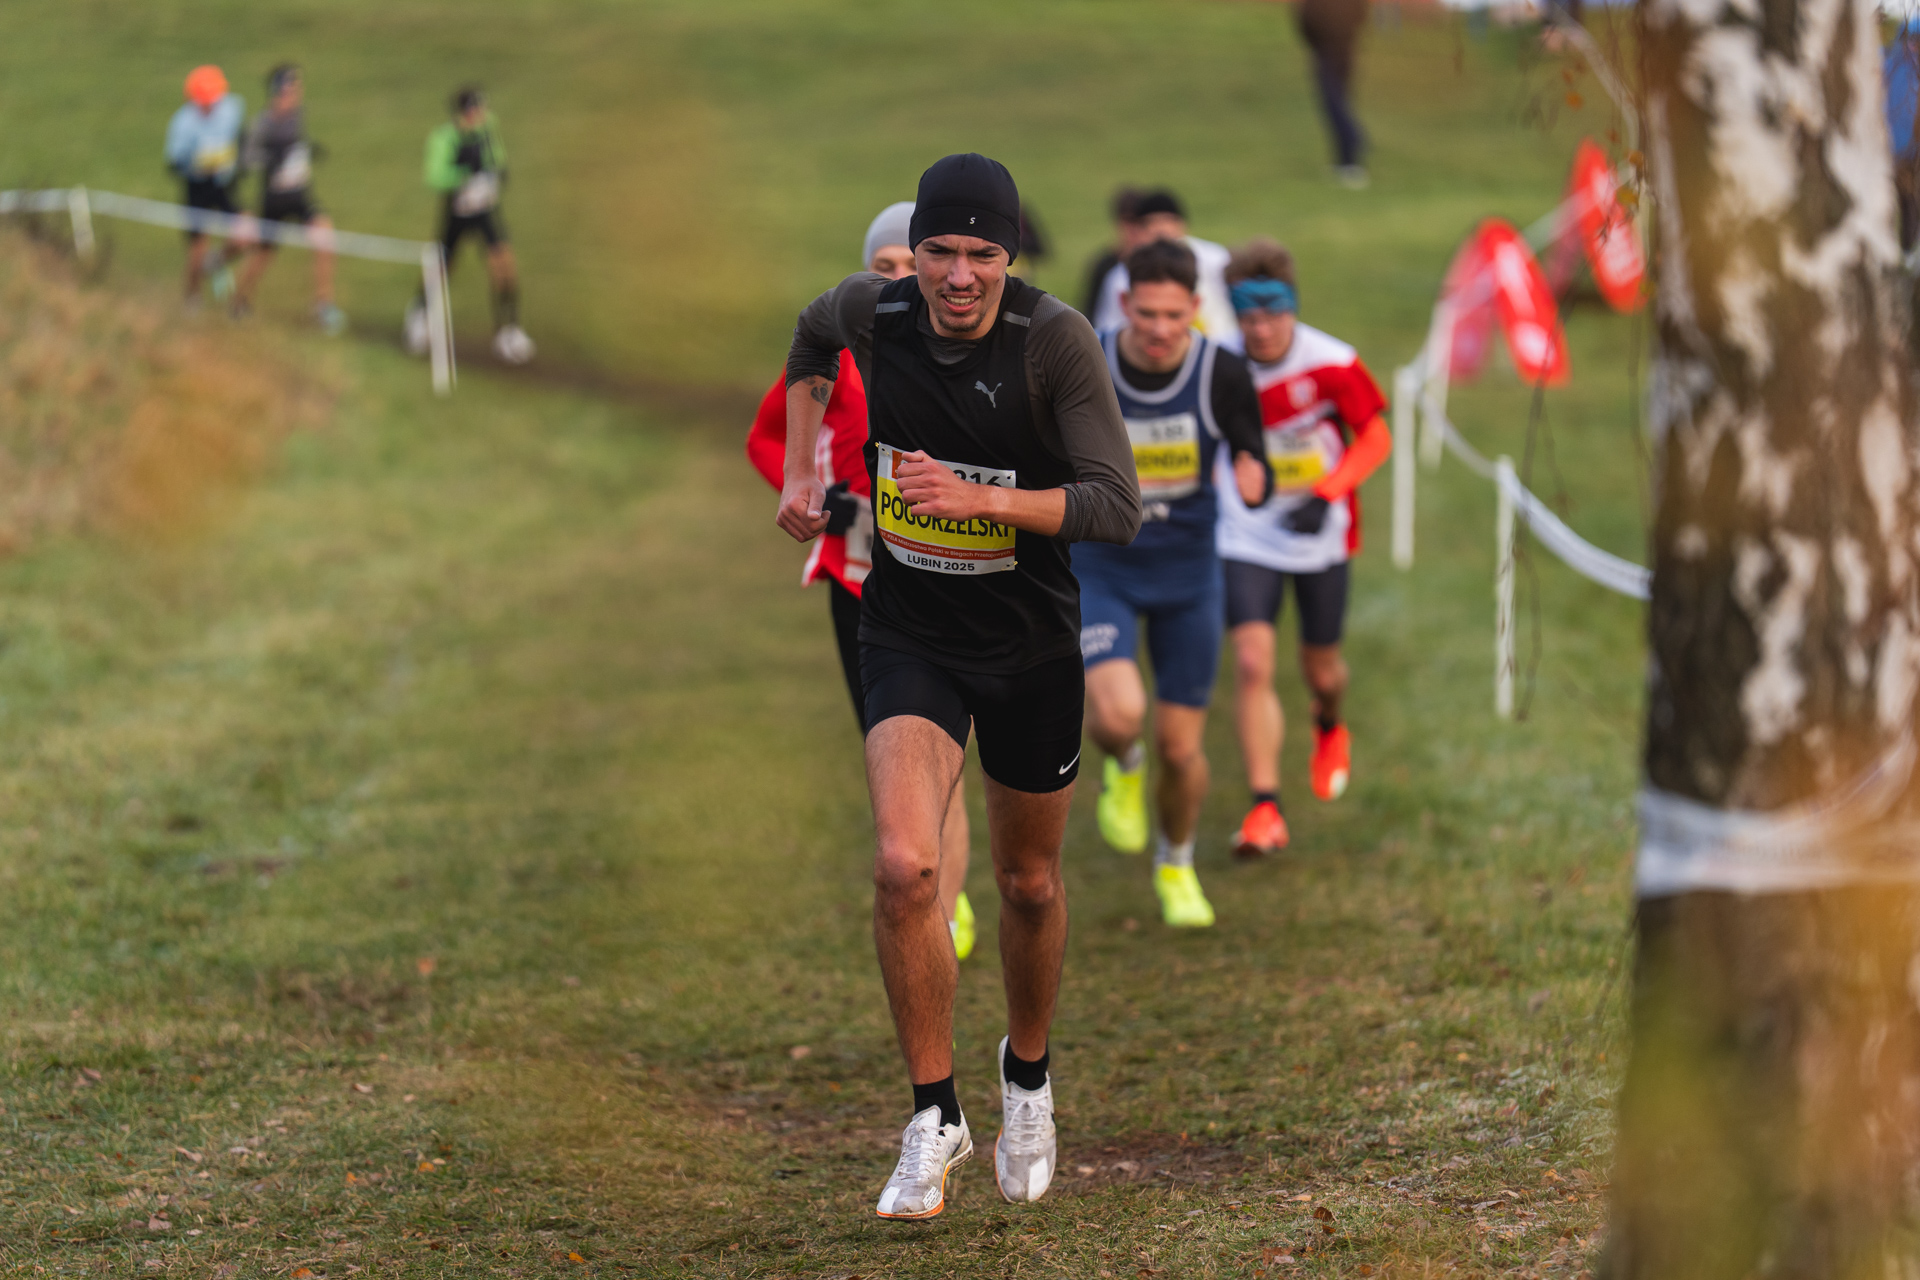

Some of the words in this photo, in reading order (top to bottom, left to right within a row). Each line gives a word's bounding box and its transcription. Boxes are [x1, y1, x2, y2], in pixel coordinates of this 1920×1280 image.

[927, 547, 944, 555] Polski
[950, 550, 974, 558] Biegach
[907, 553, 942, 569] LUBIN
[943, 561, 976, 571] 2025
